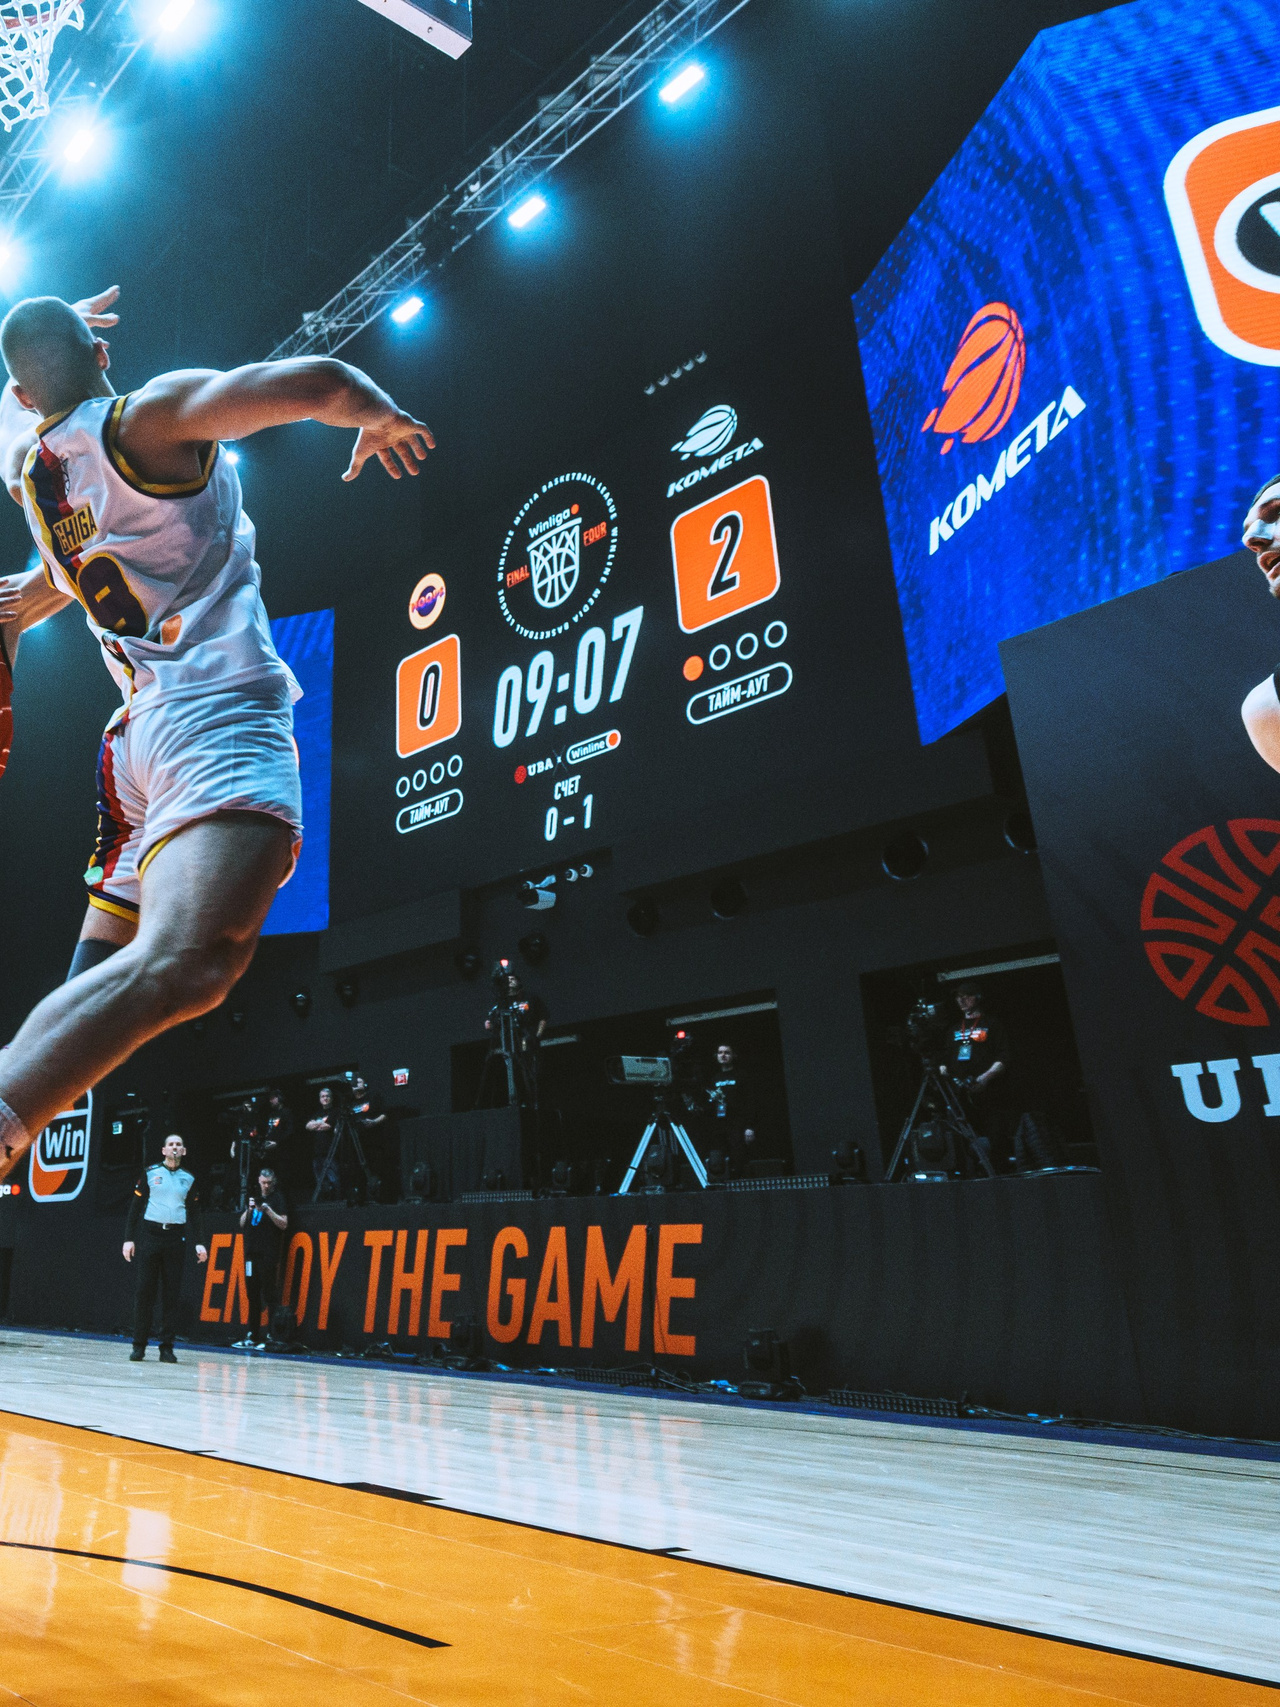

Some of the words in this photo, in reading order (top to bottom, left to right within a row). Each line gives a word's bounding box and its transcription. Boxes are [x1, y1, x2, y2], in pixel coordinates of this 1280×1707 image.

[497, 530, 515, 582] WINLINE
[513, 493, 539, 526] MEDIA
[541, 472, 596, 493] BASKETBALL
[596, 482, 618, 520] LEAGUE
[528, 508, 570, 538] Winliga
[506, 565, 530, 588] FINAL
[583, 521, 607, 547] FOUR
[707, 510, 744, 601] 2
[572, 588, 601, 623] MEDIA
[417, 660, 442, 730] 0
[492, 605, 643, 748] 09:07
[708, 673, 770, 712] ТАЙМ-АУТ
[527, 758, 554, 777] UBA
[571, 740, 605, 759] Winline
[554, 775, 581, 800] СЧЕТ
[409, 797, 450, 825] ТАЙМ-АУТ
[544, 806, 558, 841] 0
[583, 794, 593, 828] 1
[45, 1123, 85, 1159] Win
[199, 1231, 349, 1331] ENOY
[363, 1228, 468, 1339] THE
[486, 1223, 703, 1356] GAME
